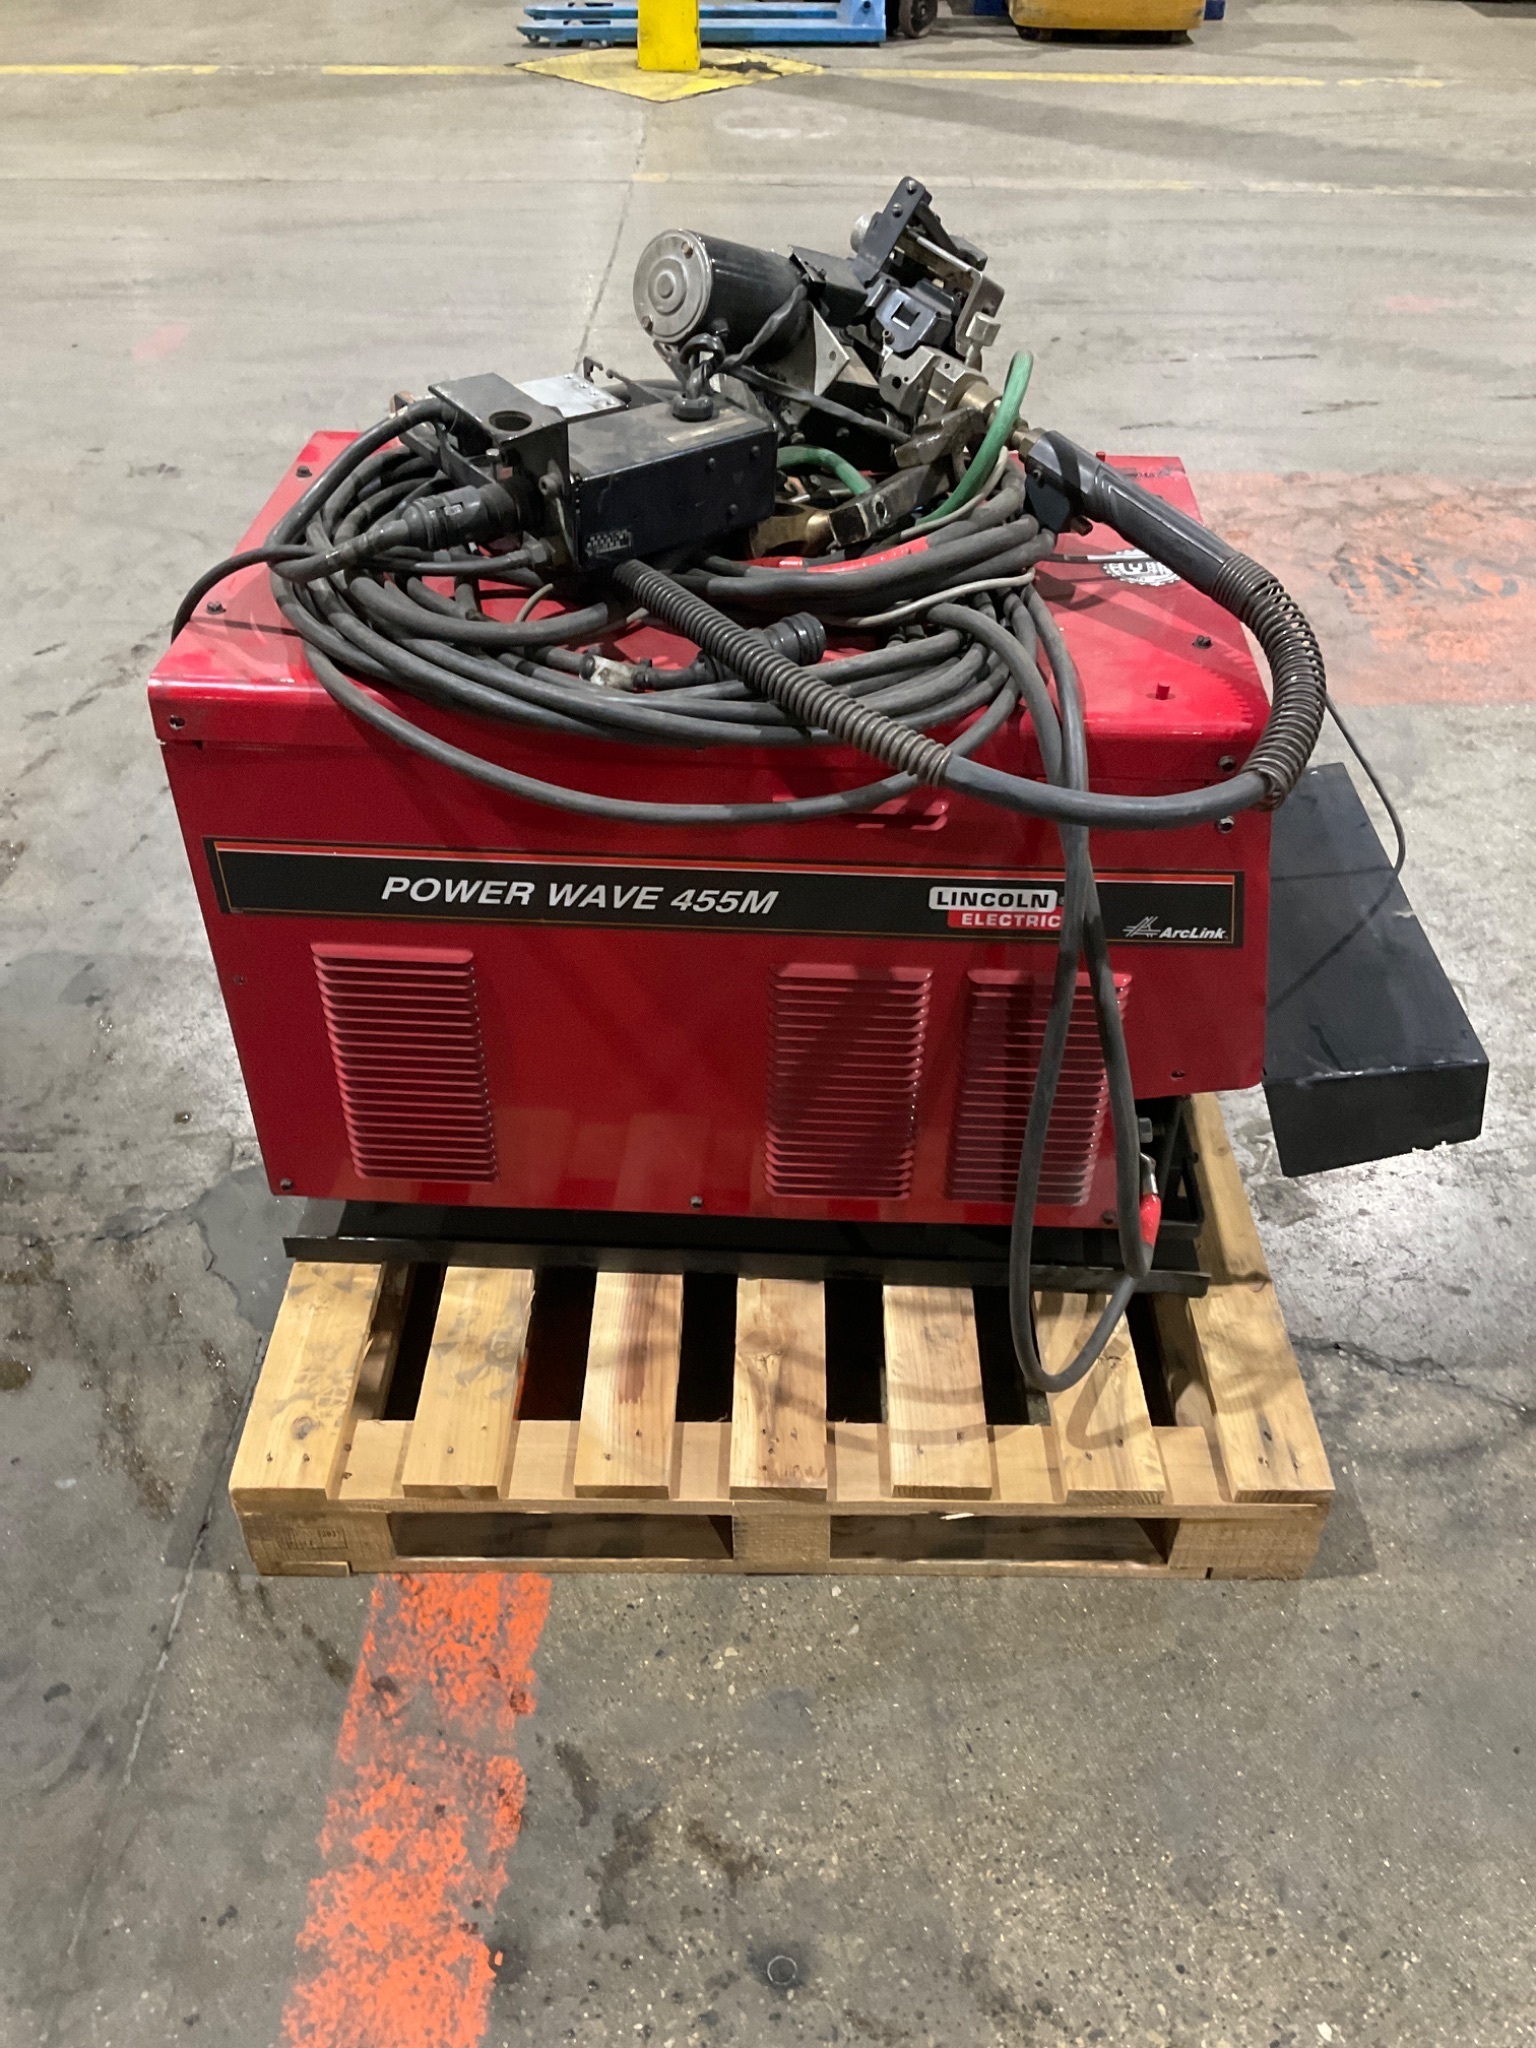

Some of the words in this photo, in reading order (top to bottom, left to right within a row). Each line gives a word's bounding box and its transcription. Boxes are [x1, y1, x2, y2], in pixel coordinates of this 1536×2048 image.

[381, 876, 535, 906] POWER
[548, 882, 664, 910] WAVE
[670, 888, 779, 915] 455M
[936, 891, 1049, 909] LINCOLN
[961, 912, 1062, 928] ELECTRIC
[1159, 926, 1226, 939] ArcLink
